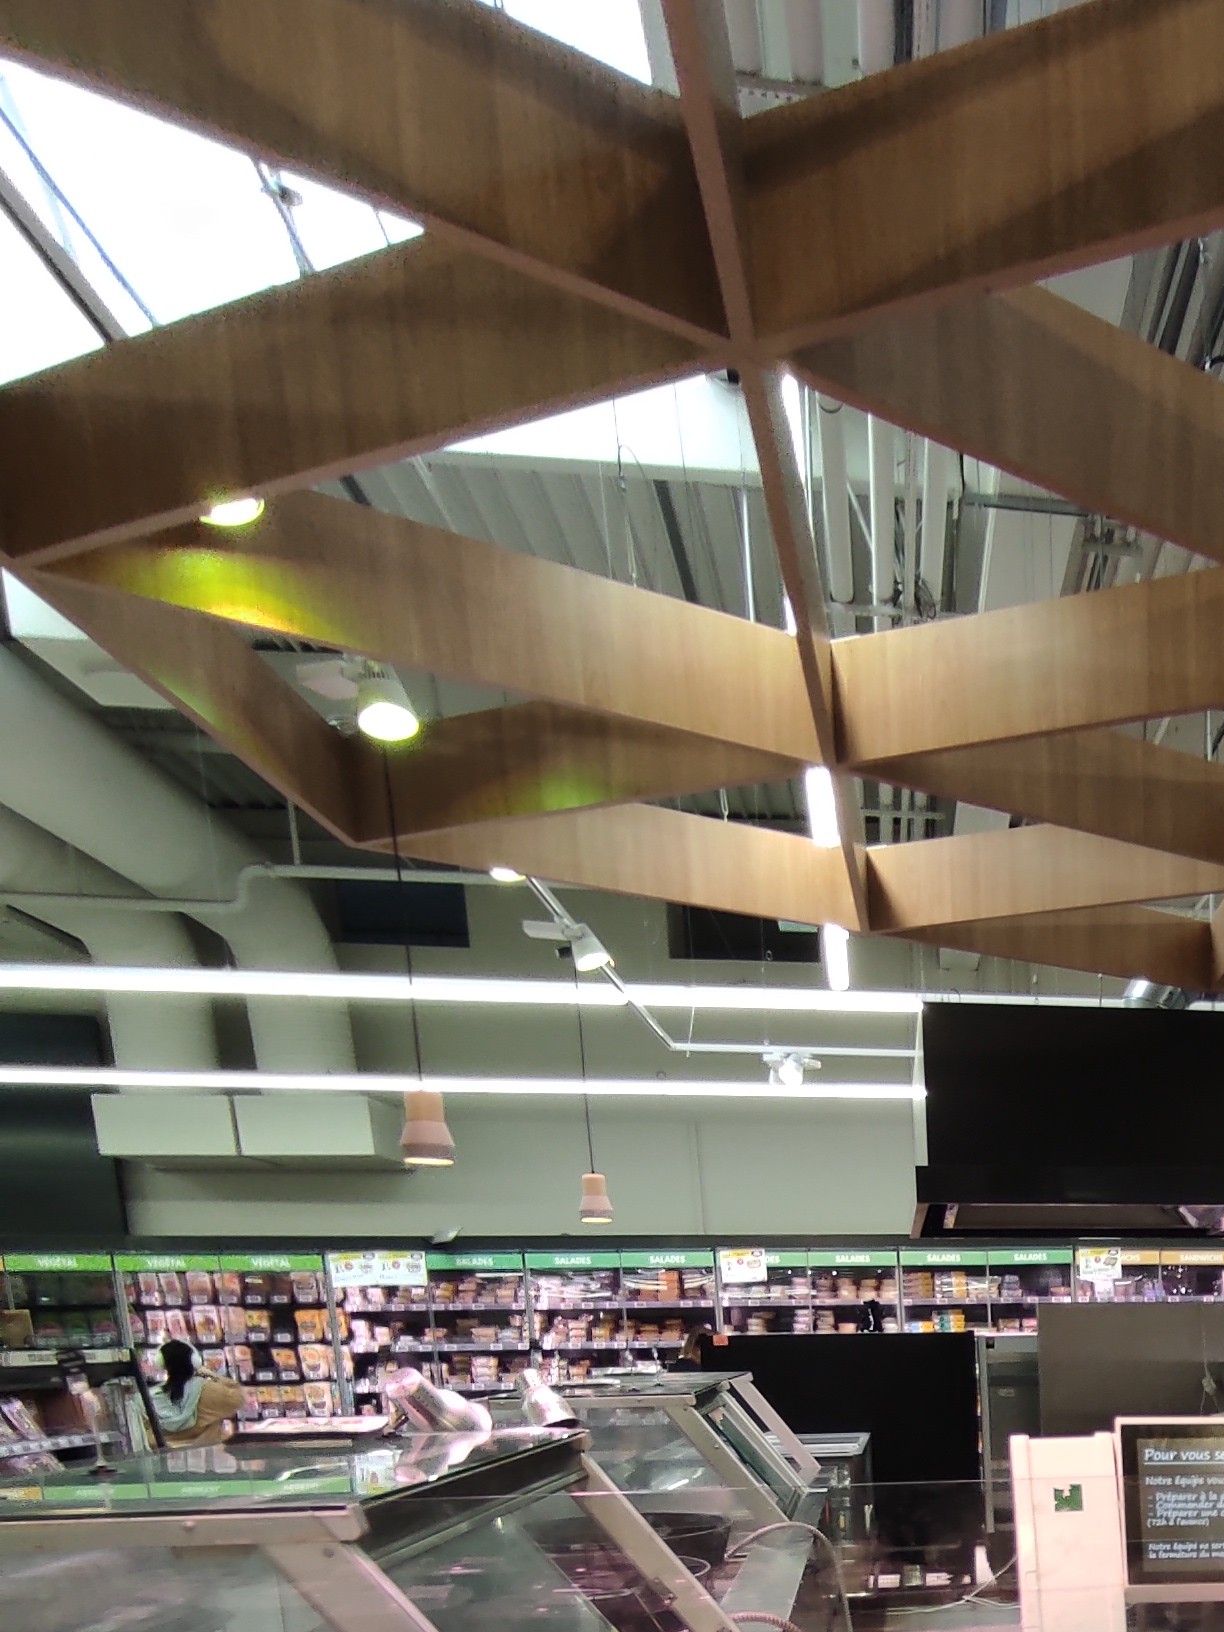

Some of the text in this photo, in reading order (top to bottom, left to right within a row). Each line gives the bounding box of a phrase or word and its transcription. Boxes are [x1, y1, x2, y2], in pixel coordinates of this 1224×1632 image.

[554, 1256, 592, 1265] SALADES
[649, 1255, 686, 1264] SALADES
[835, 1254, 871, 1263] SALADES
[926, 1254, 961, 1263] SALADES
[1013, 1253, 1048, 1262] SALADES
[1144, 1449, 1178, 1461] Pour
[1181, 1450, 1211, 1461] vous
